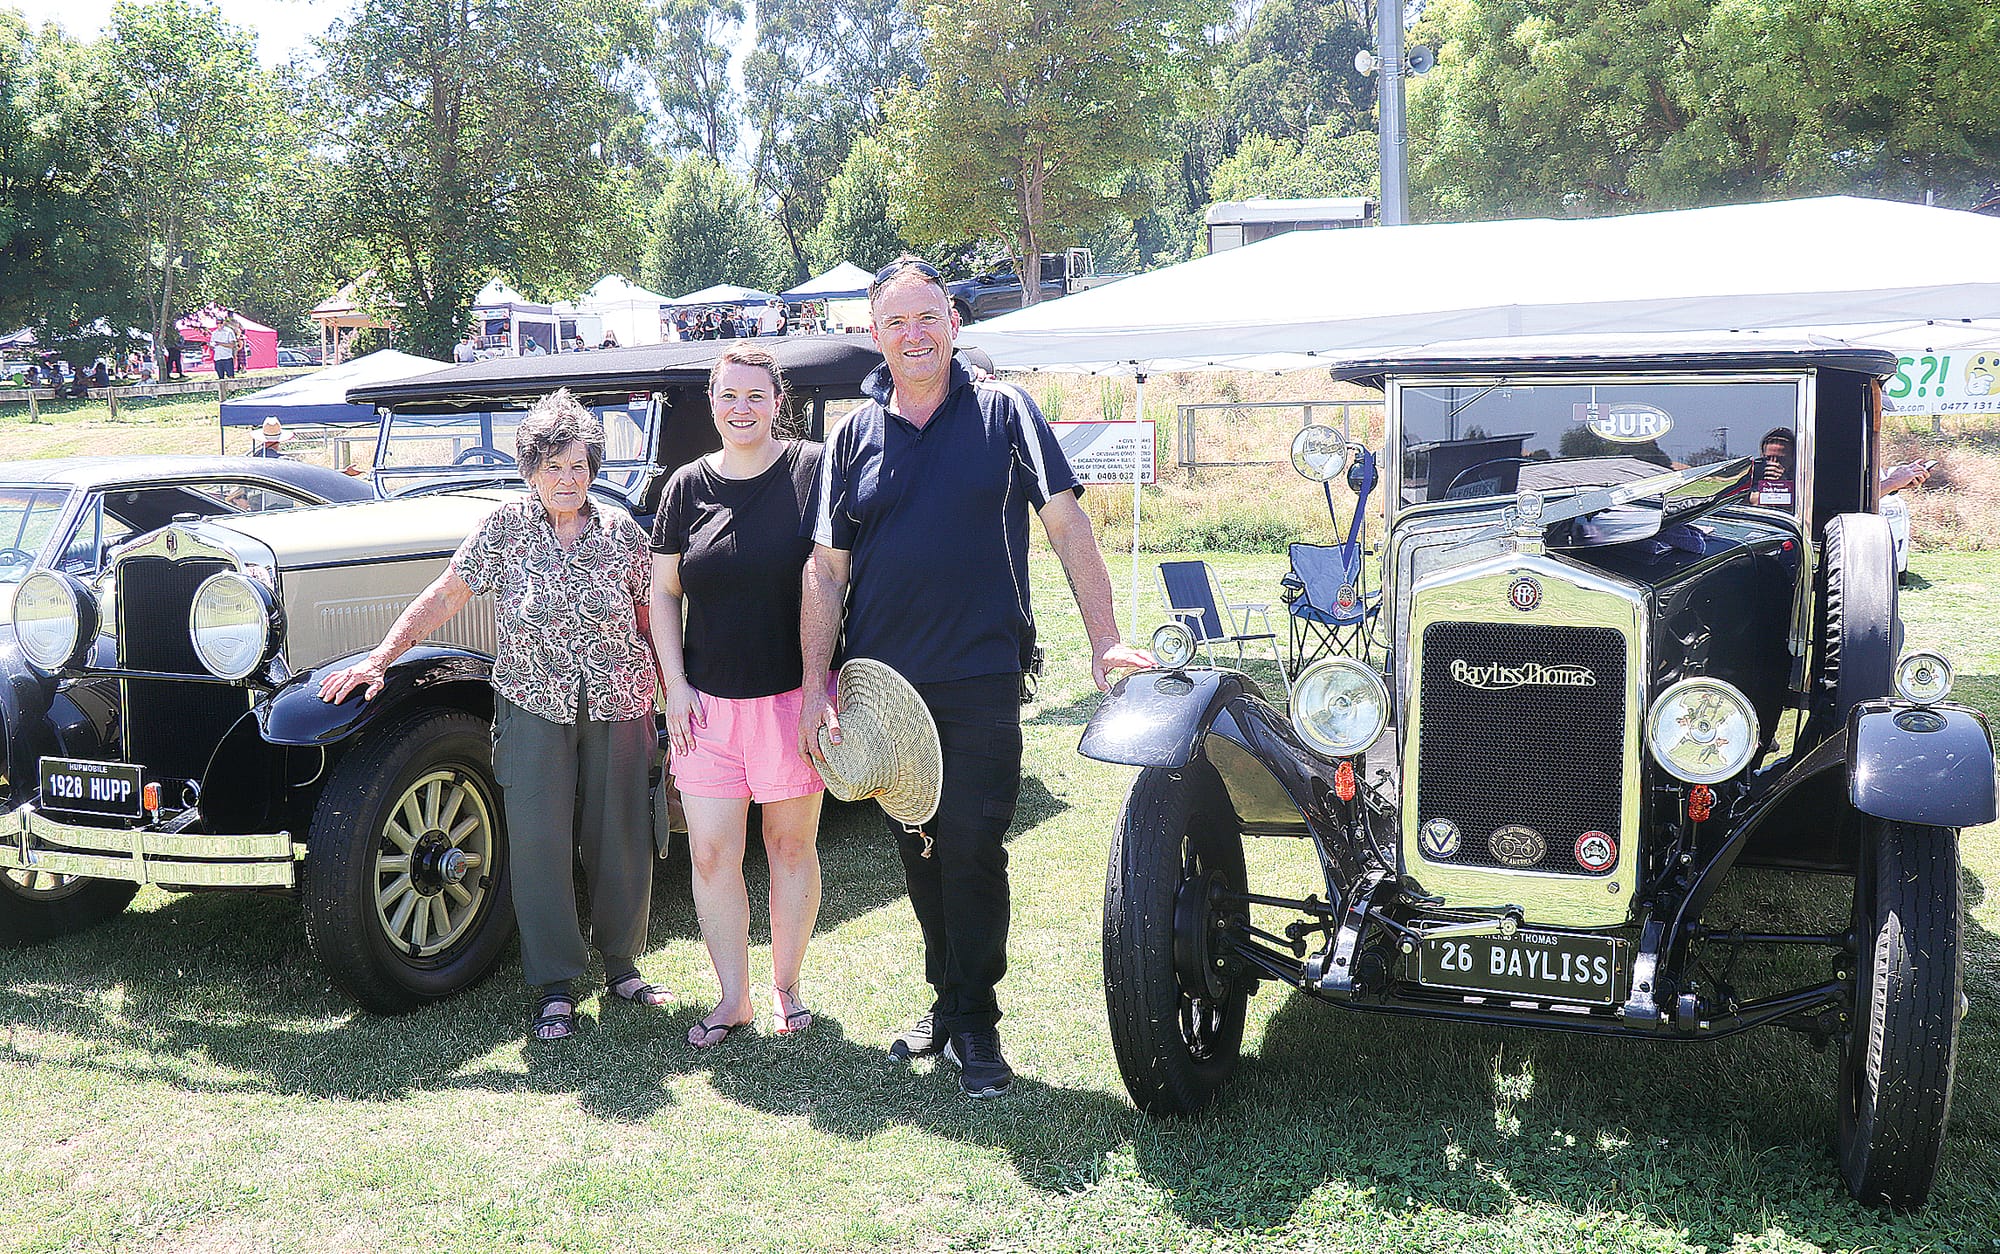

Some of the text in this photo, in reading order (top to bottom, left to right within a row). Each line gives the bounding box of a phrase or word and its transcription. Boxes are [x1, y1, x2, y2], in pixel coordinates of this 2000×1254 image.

[1888, 355, 1951, 398] S?!
[1897, 404, 1925, 412] e.com
[1940, 402, 1969, 411] 0477
[1973, 402, 1992, 410] 131
[1077, 472, 1091, 480] AK
[68, 763, 108, 774] HUPMOBILE
[49, 773, 131, 803] 1928 HUPP
[1519, 933, 1558, 945] THOMAS
[1490, 946, 1608, 985] BAYLISS
